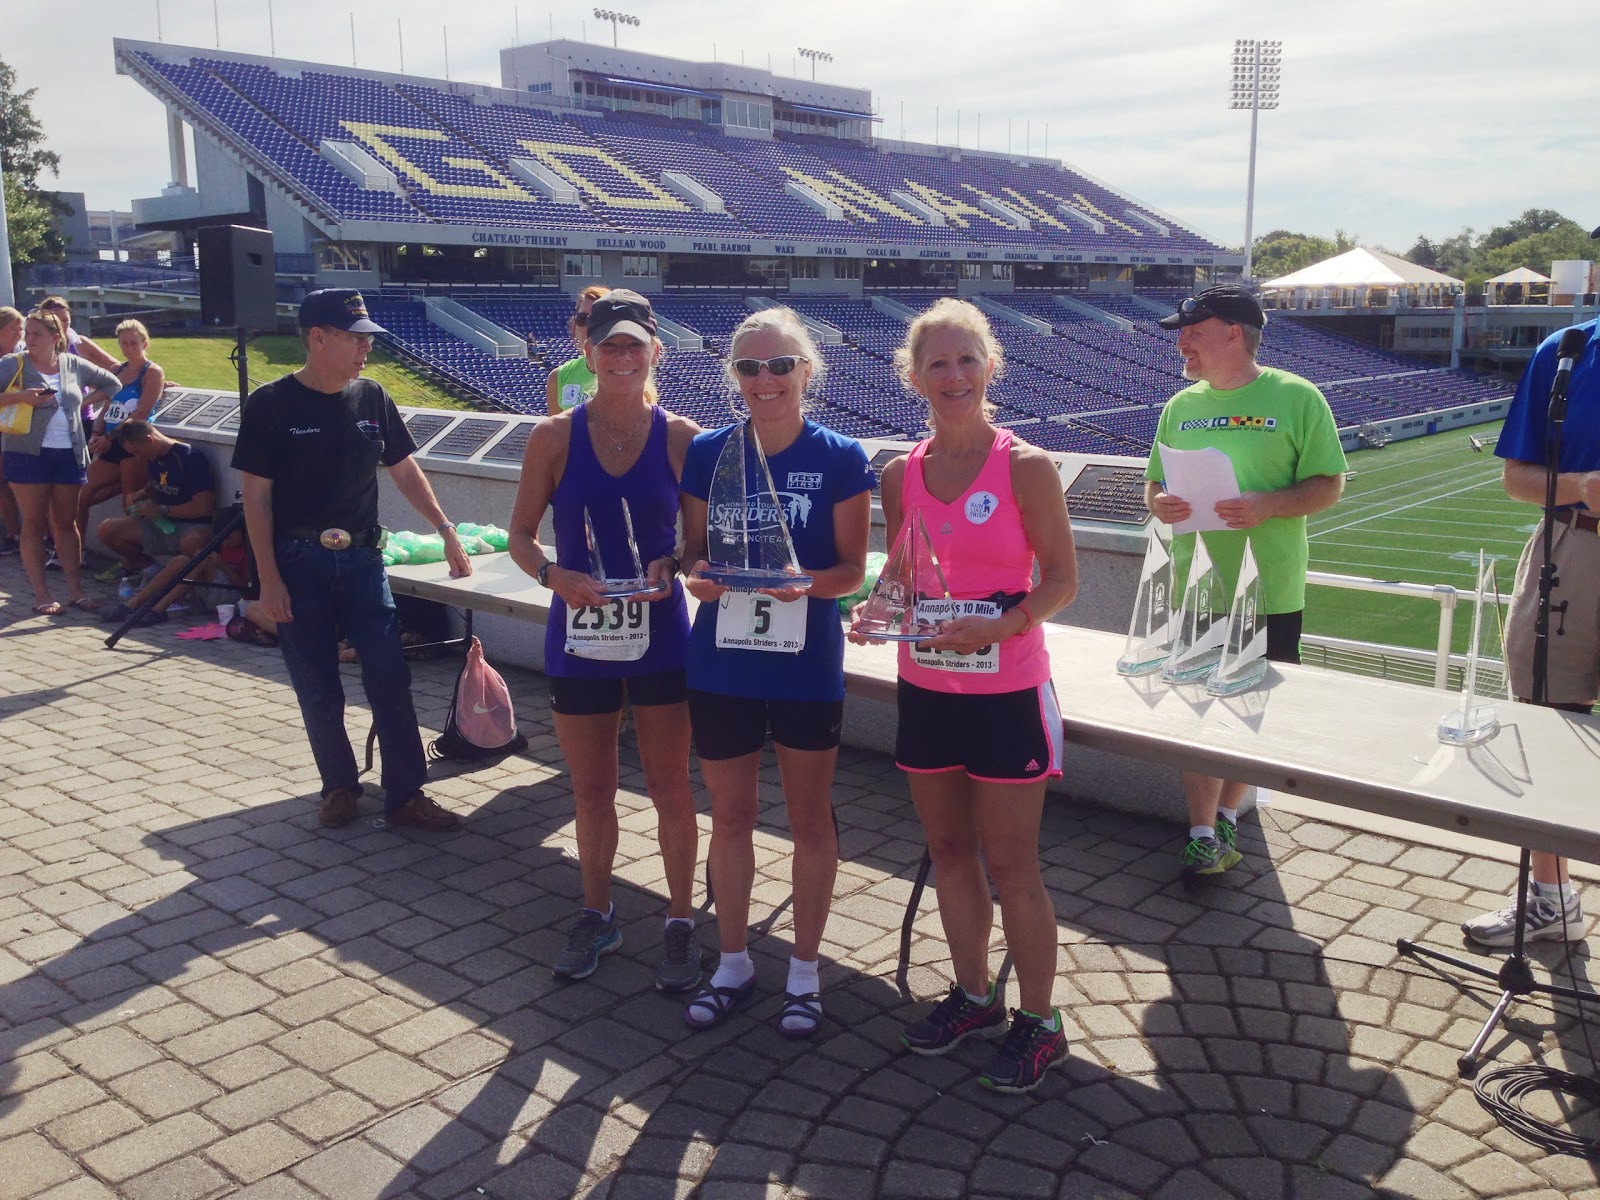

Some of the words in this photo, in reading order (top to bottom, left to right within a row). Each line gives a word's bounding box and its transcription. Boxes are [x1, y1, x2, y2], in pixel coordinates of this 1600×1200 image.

[337, 119, 692, 213] GO
[778, 166, 1144, 238] NAVY
[471, 232, 568, 247] CHATEAU-THIERRY
[596, 238, 636, 249] BELLEAU
[640, 240, 666, 250] WOOD
[692, 242, 719, 252] PEARL
[720, 243, 752, 253] HARBOR
[774, 245, 796, 254] WAKE
[816, 246, 833, 255] JAVA
[833, 247, 847, 256] SEA
[866, 248, 888, 256] CORAL
[889, 249, 901, 257] SEA
[919, 250, 951, 258] ALEUTIANS
[966, 251, 989, 259] MIDWAY
[1004, 252, 1039, 260] GUADALCANAL
[289, 427, 321, 436] Theodore
[572, 597, 643, 630] 2539
[918, 602, 960, 615] Annapos
[963, 602, 973, 613] 10
[975, 603, 995, 615] Mile
[754, 600, 771, 635] 5
[573, 634, 600, 642] Annapolis
[601, 633, 624, 641] Striders
[629, 632, 644, 640] 2013
[722, 637, 752, 646] Annapolis
[753, 638, 778, 647] Striders
[783, 640, 799, 648] 2013
[917, 657, 944, 667] Annapolis
[945, 659, 970, 668] Striders
[976, 661, 992, 669] 2013
